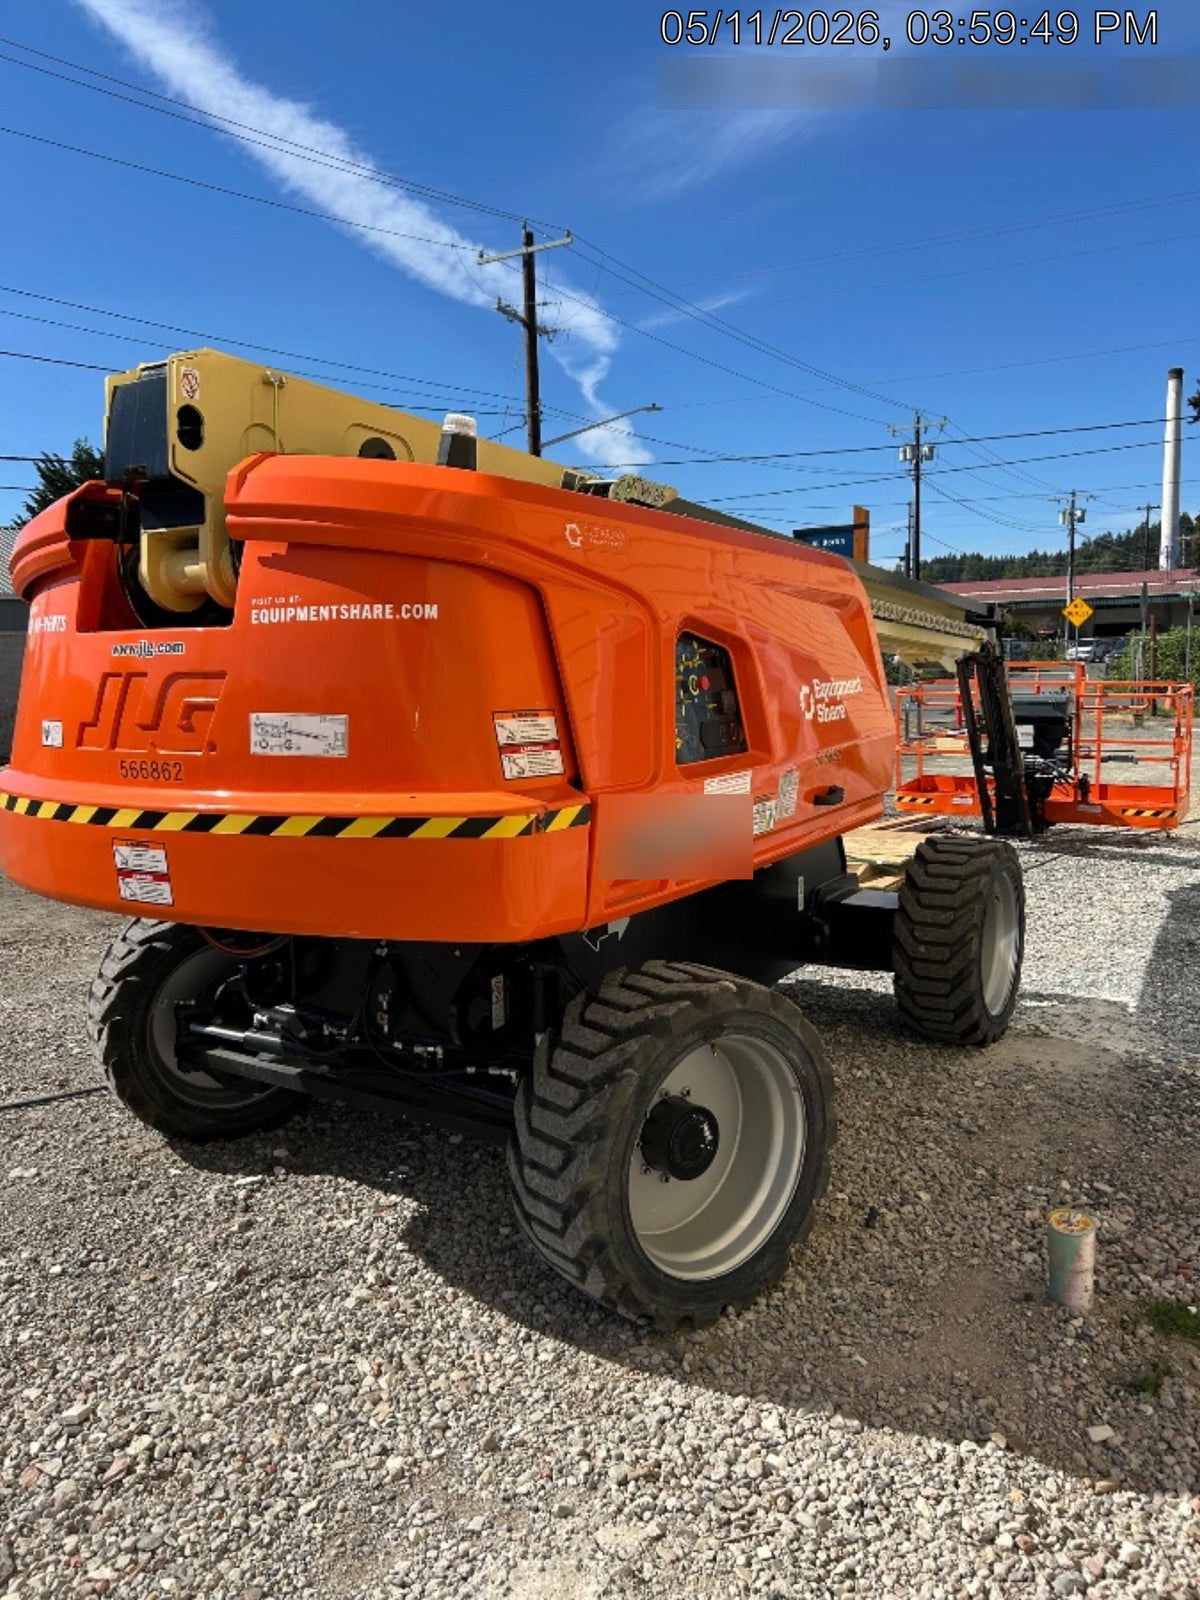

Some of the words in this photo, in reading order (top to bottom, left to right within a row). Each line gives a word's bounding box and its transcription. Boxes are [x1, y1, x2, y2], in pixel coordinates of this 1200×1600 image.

[251, 603, 438, 625] EQUIPMENTSHARE.COM
[76, 670, 228, 755] JLG
[119, 760, 183, 781] 566862
